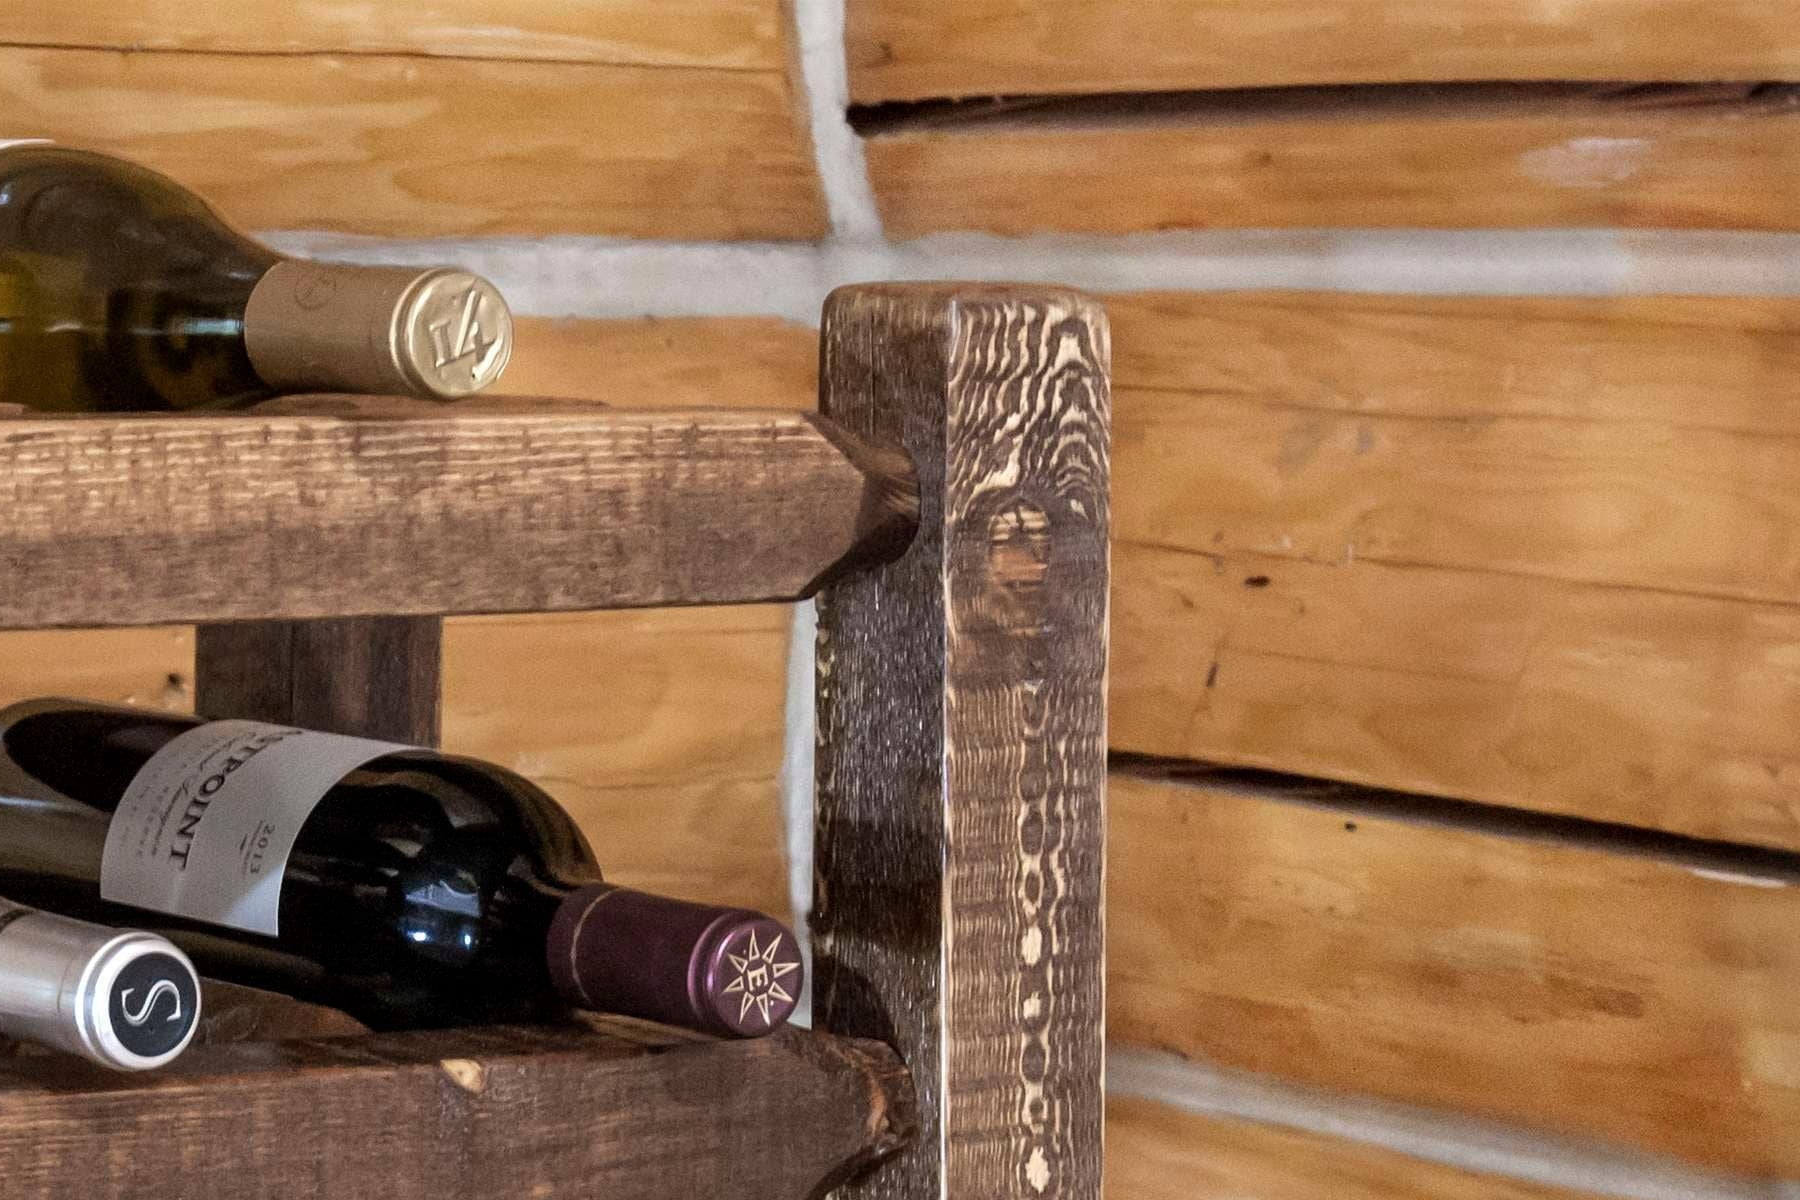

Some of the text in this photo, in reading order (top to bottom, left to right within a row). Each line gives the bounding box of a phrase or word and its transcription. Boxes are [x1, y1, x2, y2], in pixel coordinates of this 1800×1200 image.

[429, 289, 498, 370] 14
[250, 822, 275, 875] 2013
[746, 963, 769, 992] E
[121, 979, 182, 1027] S
